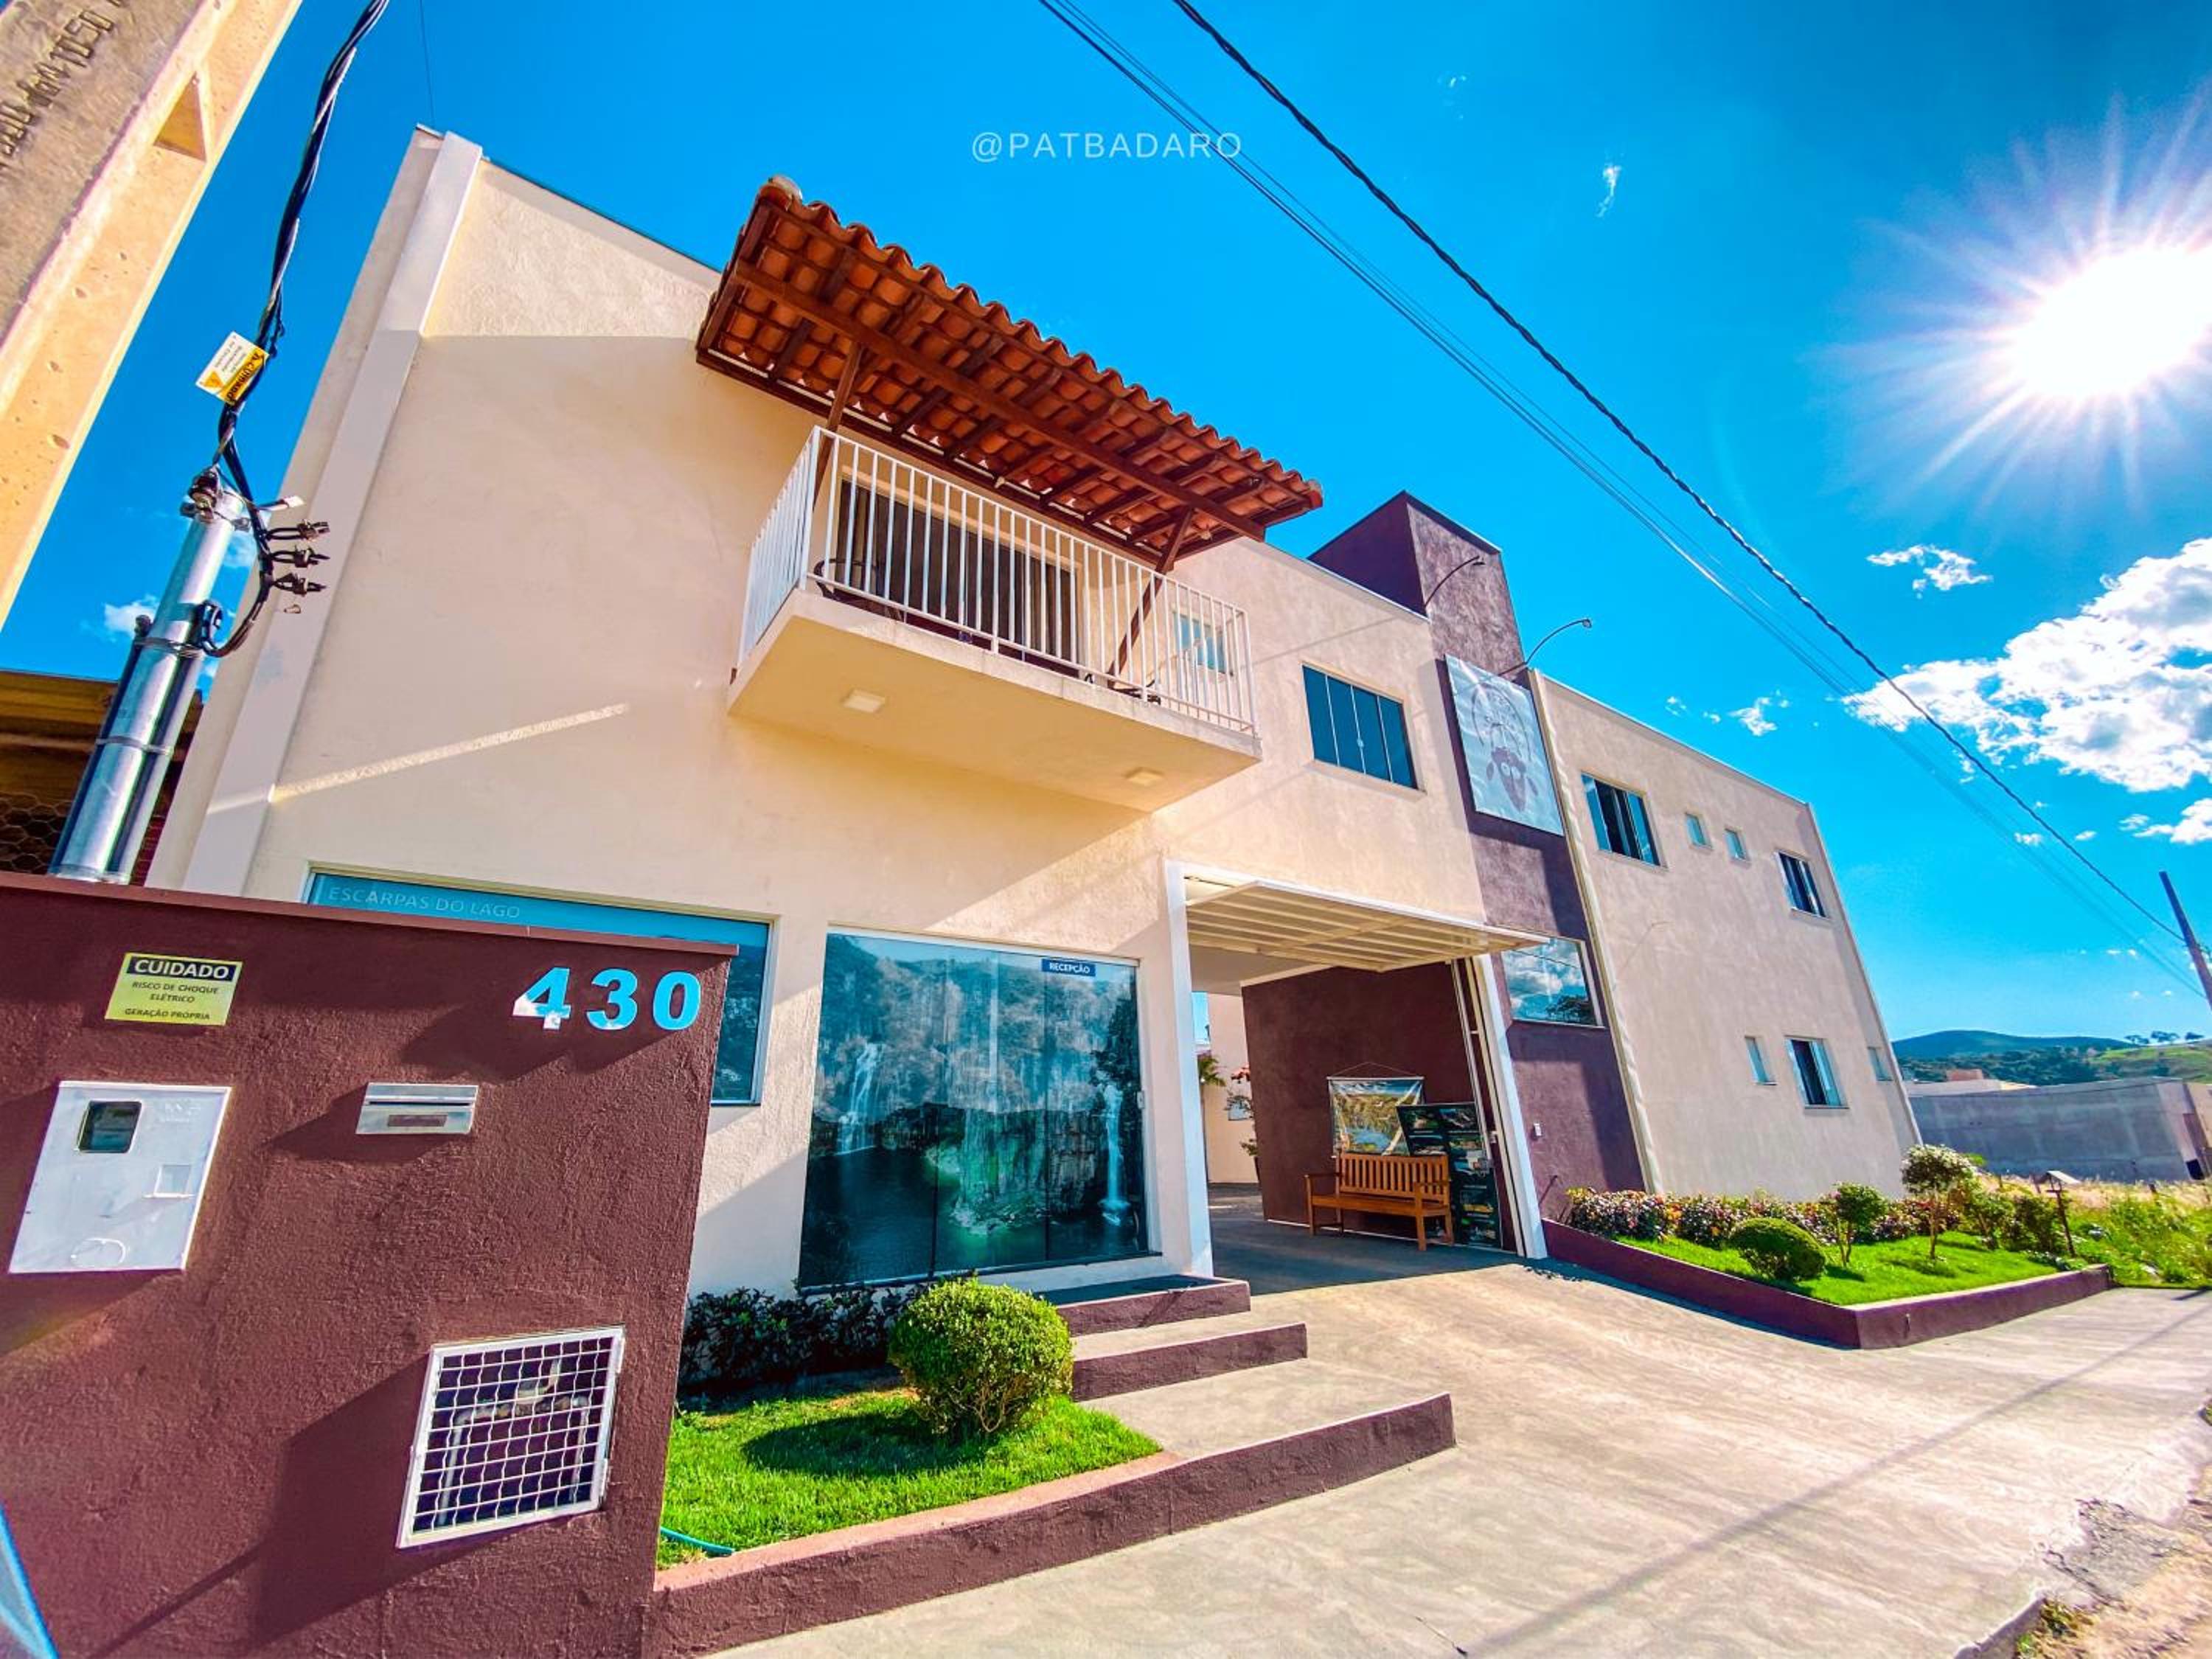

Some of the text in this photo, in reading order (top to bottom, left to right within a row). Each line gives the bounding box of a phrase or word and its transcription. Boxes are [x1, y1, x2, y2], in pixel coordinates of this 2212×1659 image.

[327, 886, 520, 919] ESCARPAS DO LAGO
[134, 959, 229, 979] CUIDADO
[1049, 961, 1091, 974] RECEPÇÃO
[132, 981, 220, 994] RISCO DE CHOQUE
[150, 992, 195, 1003] ELÉTRICO
[512, 966, 702, 1031] 430
[125, 1008, 169, 1018] GERAÇÃO
